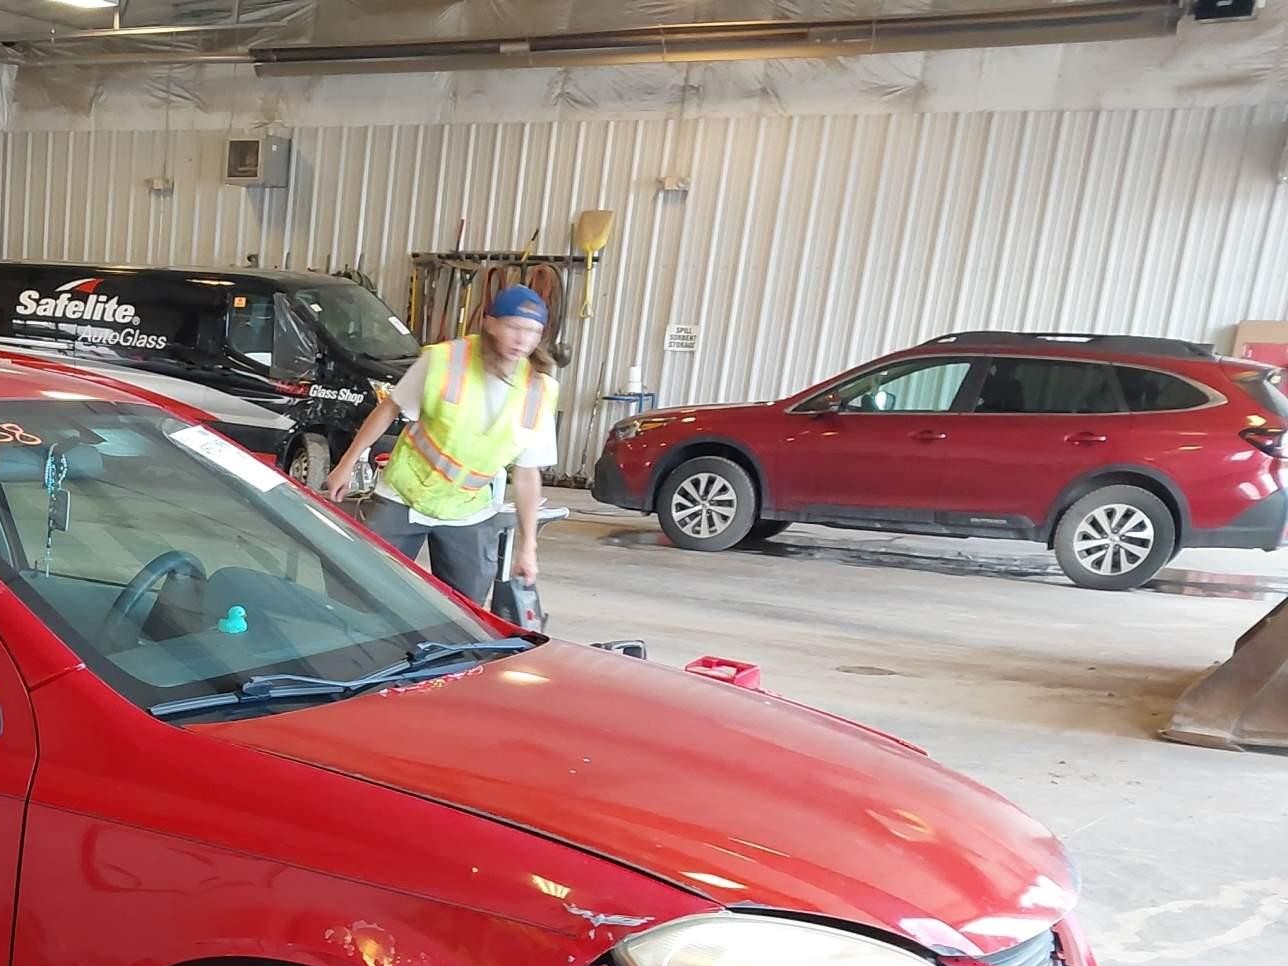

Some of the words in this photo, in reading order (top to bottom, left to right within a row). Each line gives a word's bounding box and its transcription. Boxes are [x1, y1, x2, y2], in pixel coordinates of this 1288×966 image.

[78, 324, 167, 349] AutoGlass
[308, 384, 338, 400] Glass
[337, 388, 365, 406] Shop
